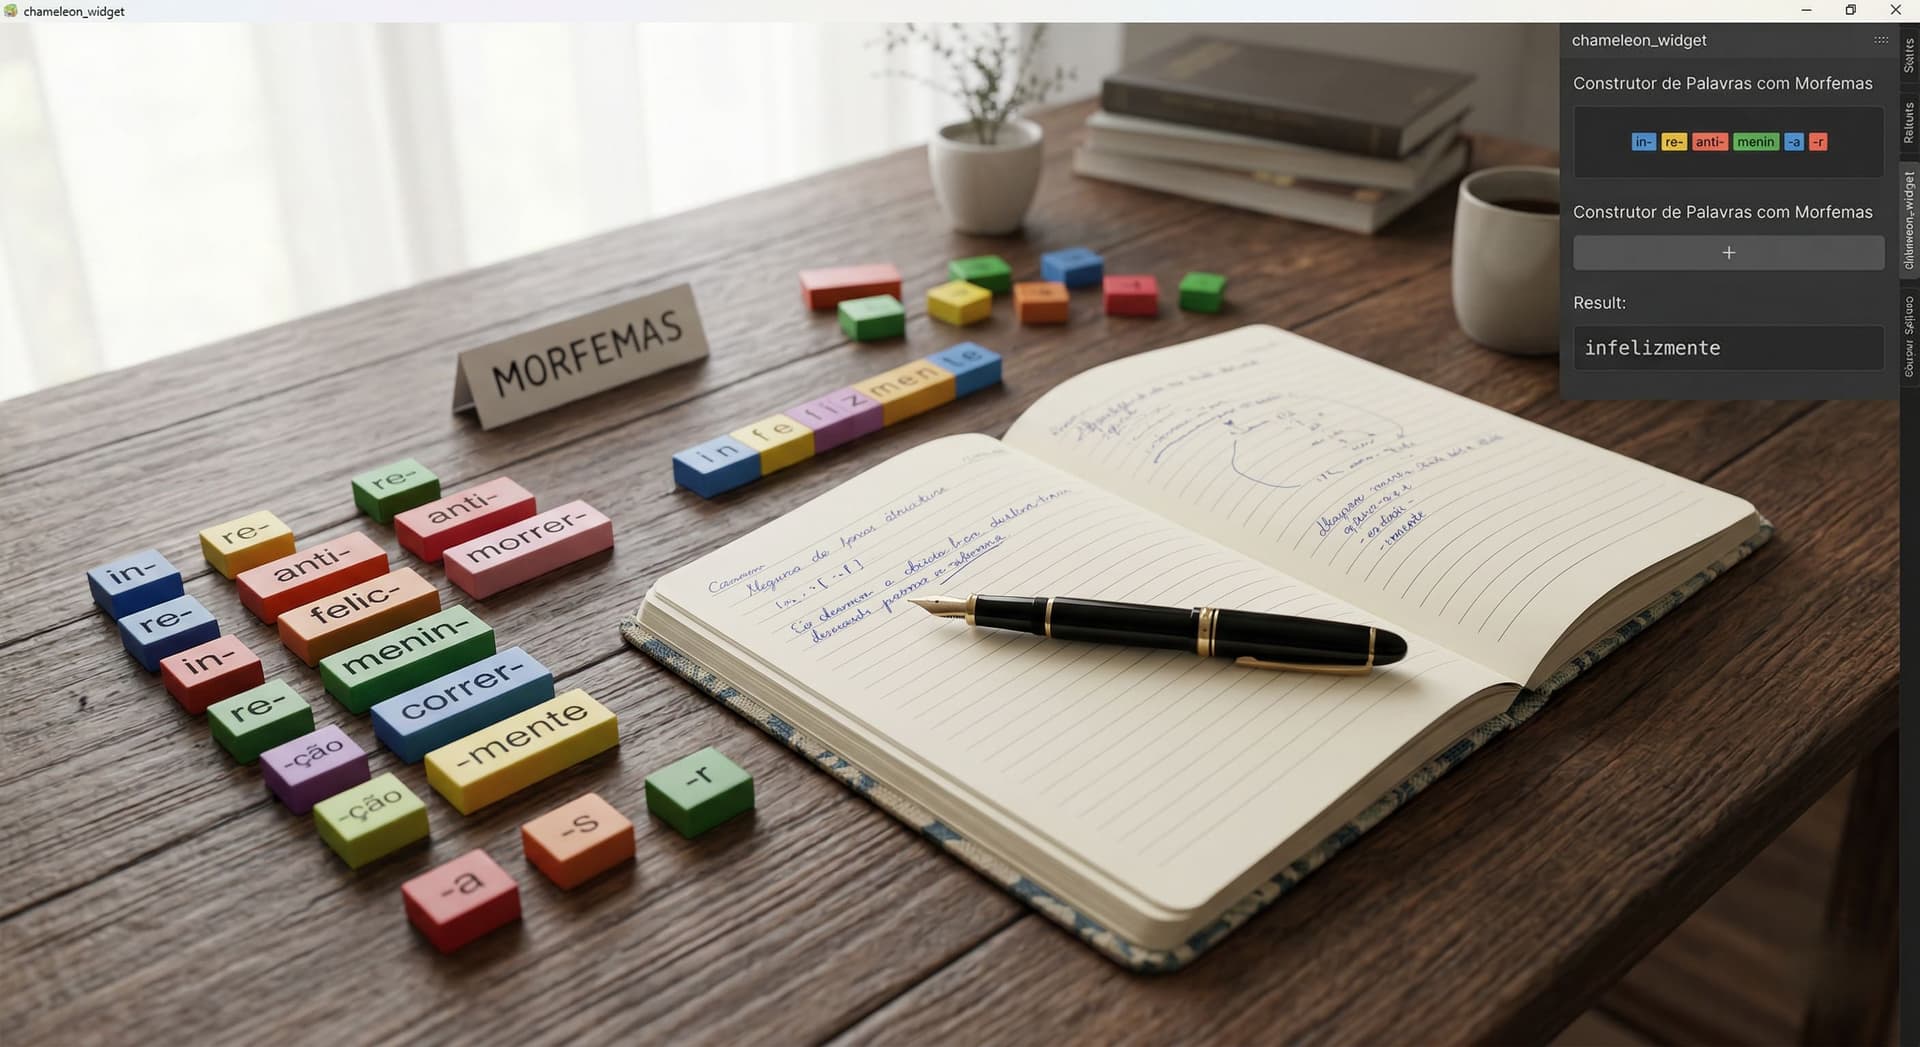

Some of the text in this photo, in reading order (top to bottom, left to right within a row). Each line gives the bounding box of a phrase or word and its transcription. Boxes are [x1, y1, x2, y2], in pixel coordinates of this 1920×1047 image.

[491, 310, 682, 398] MORFEMAS
[371, 470, 417, 490] re-
[428, 492, 499, 524] anti-
[221, 524, 270, 545] re-
[466, 512, 587, 563] morrer-
[109, 563, 156, 585] in-
[273, 548, 351, 583] anti-
[310, 587, 401, 624] felic-
[139, 610, 193, 633] re-
[341, 619, 470, 675] menin-
[182, 651, 236, 675] in-
[401, 663, 525, 721] correr-
[230, 695, 286, 723] re-
[456, 704, 589, 768] -mente
[283, 740, 343, 768] -ção
[686, 764, 713, 787] -r
[337, 790, 402, 822] -ção
[562, 814, 599, 839] -s
[440, 872, 485, 898] -a
